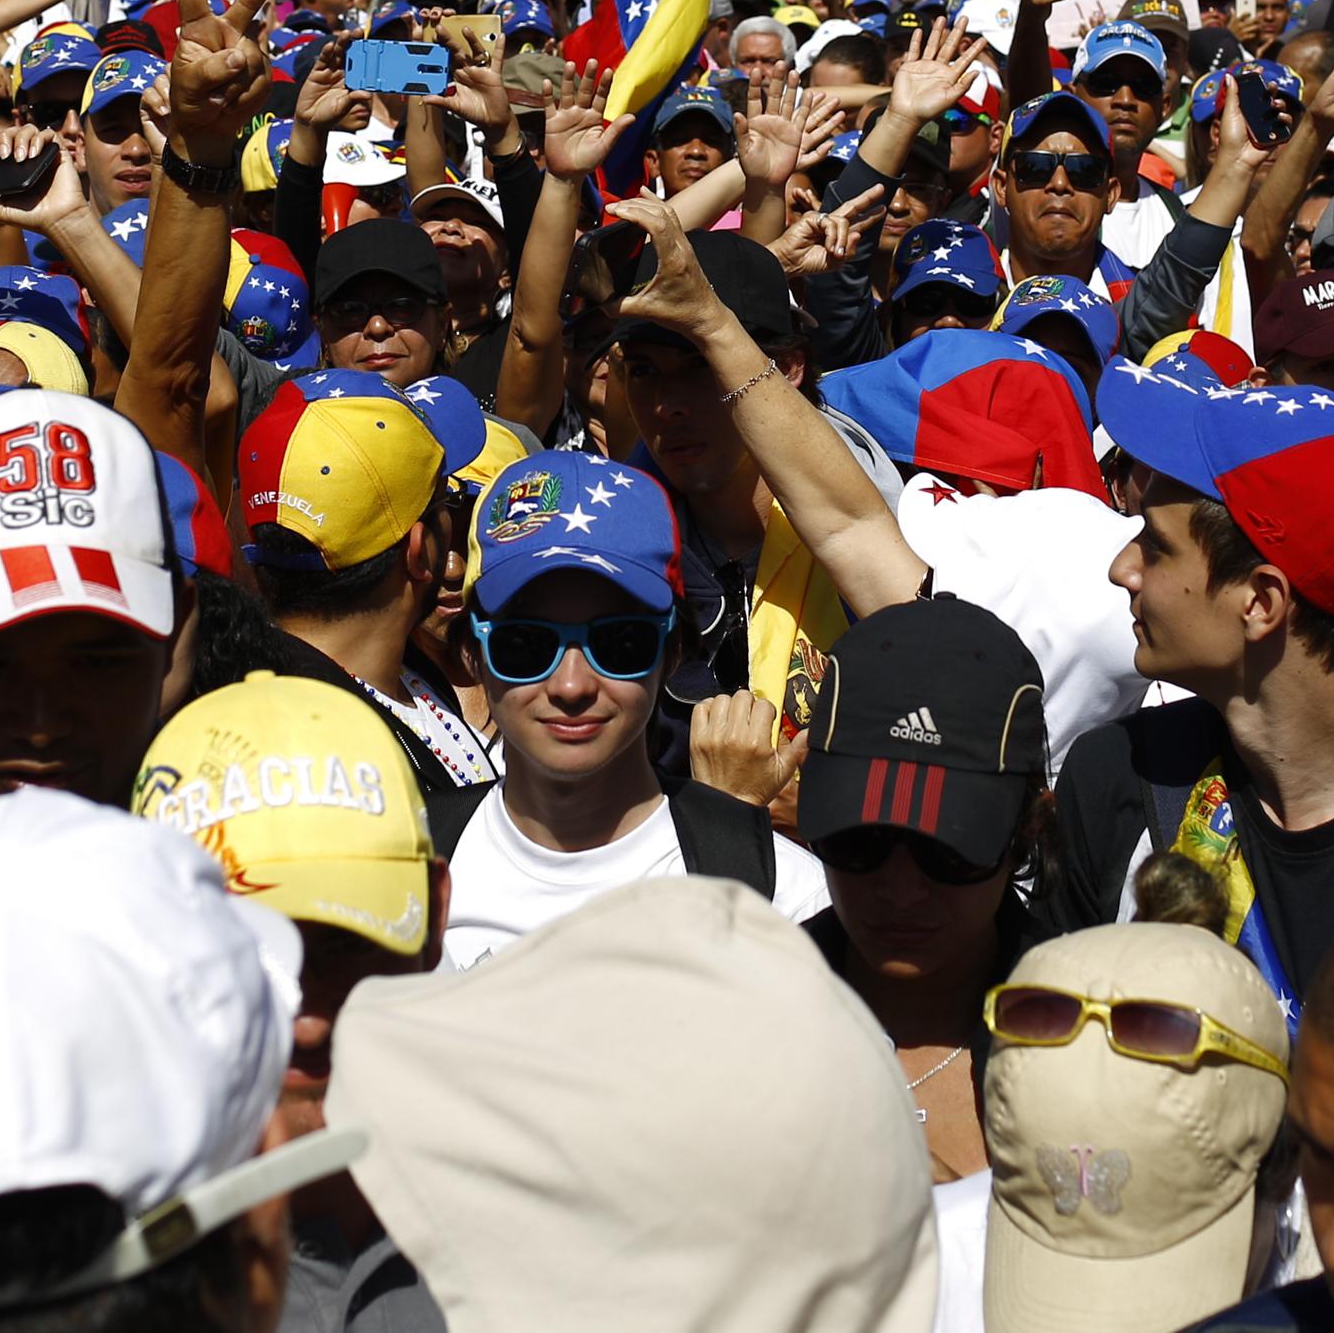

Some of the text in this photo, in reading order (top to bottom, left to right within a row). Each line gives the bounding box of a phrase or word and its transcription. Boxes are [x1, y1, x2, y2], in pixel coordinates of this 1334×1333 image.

[0, 487, 95, 529] Sic
[248, 491, 324, 527] VENEZUELA
[890, 726, 942, 745] adidas
[156, 754, 385, 835] GRACIAS
